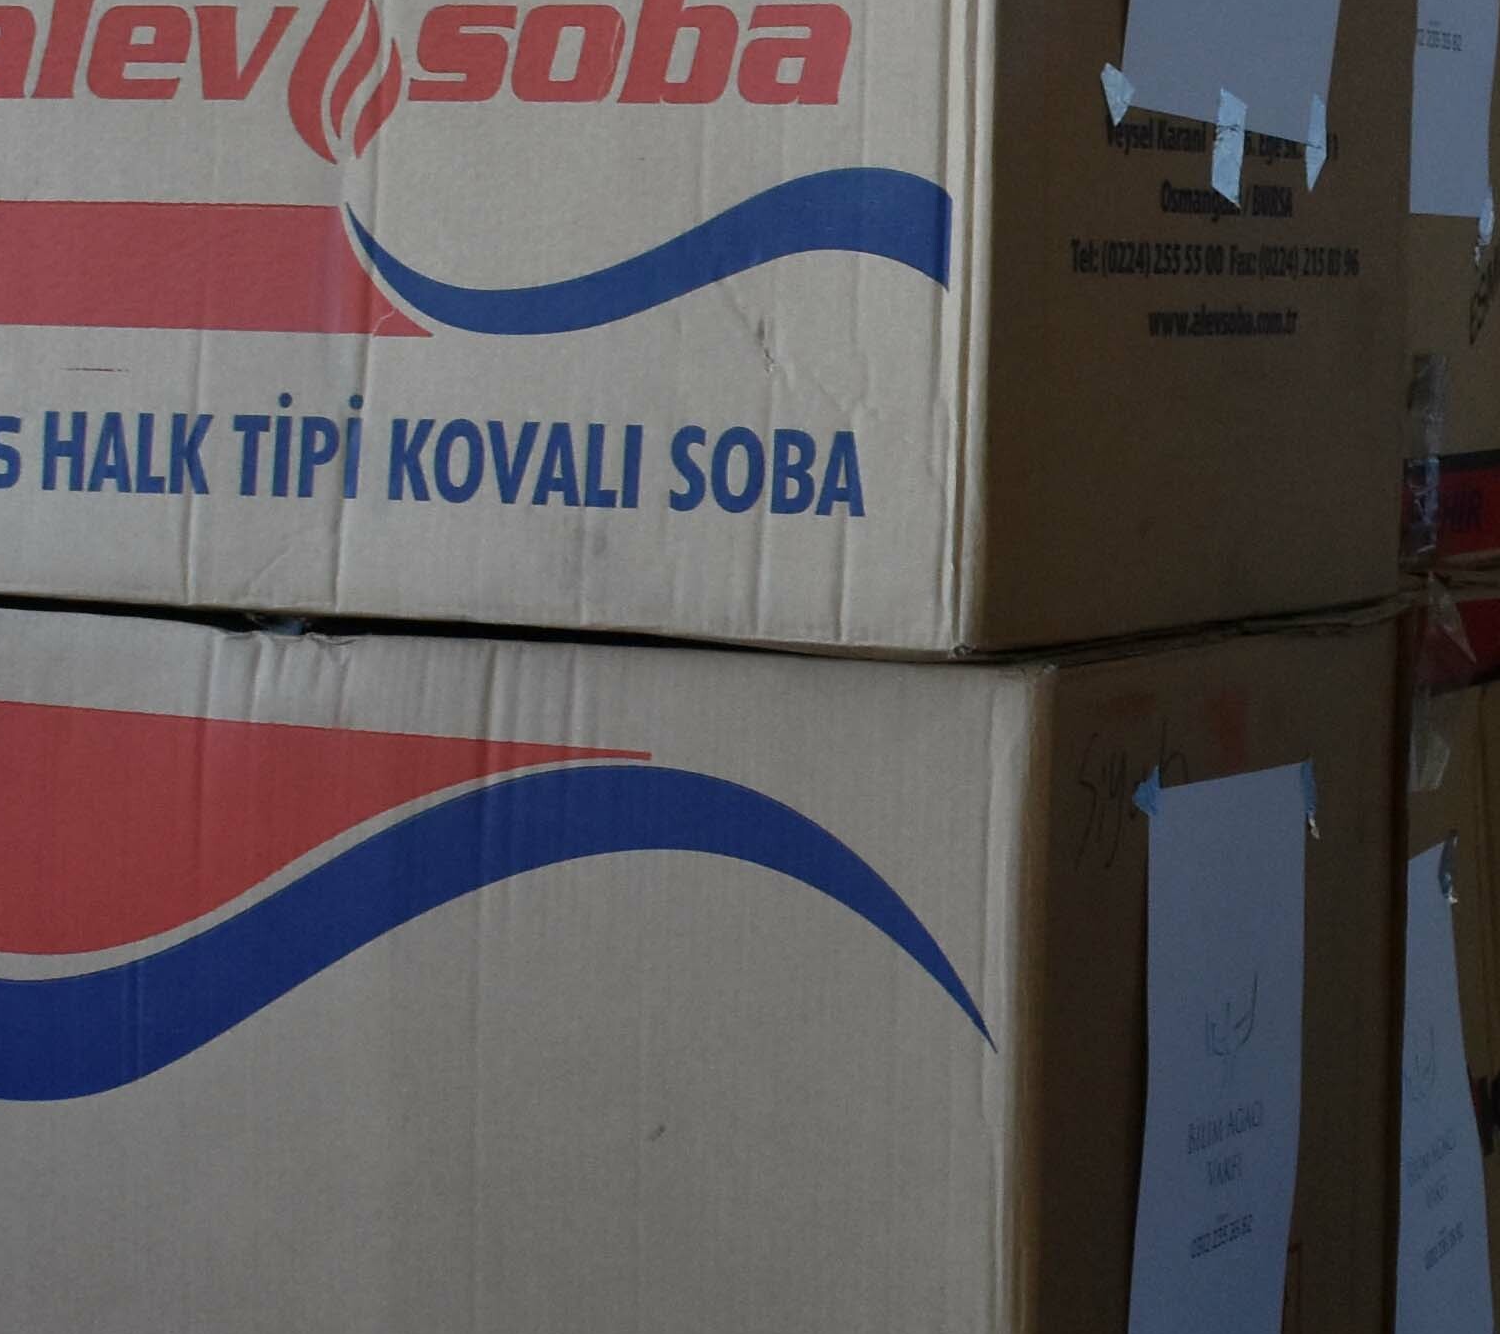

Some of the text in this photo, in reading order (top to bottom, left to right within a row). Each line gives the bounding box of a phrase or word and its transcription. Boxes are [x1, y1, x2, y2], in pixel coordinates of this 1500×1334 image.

[43, 410, 213, 497] HALK
[232, 391, 363, 502] TİPİ
[386, 416, 639, 510] KOVALI
[668, 426, 866, 519] SOBA
